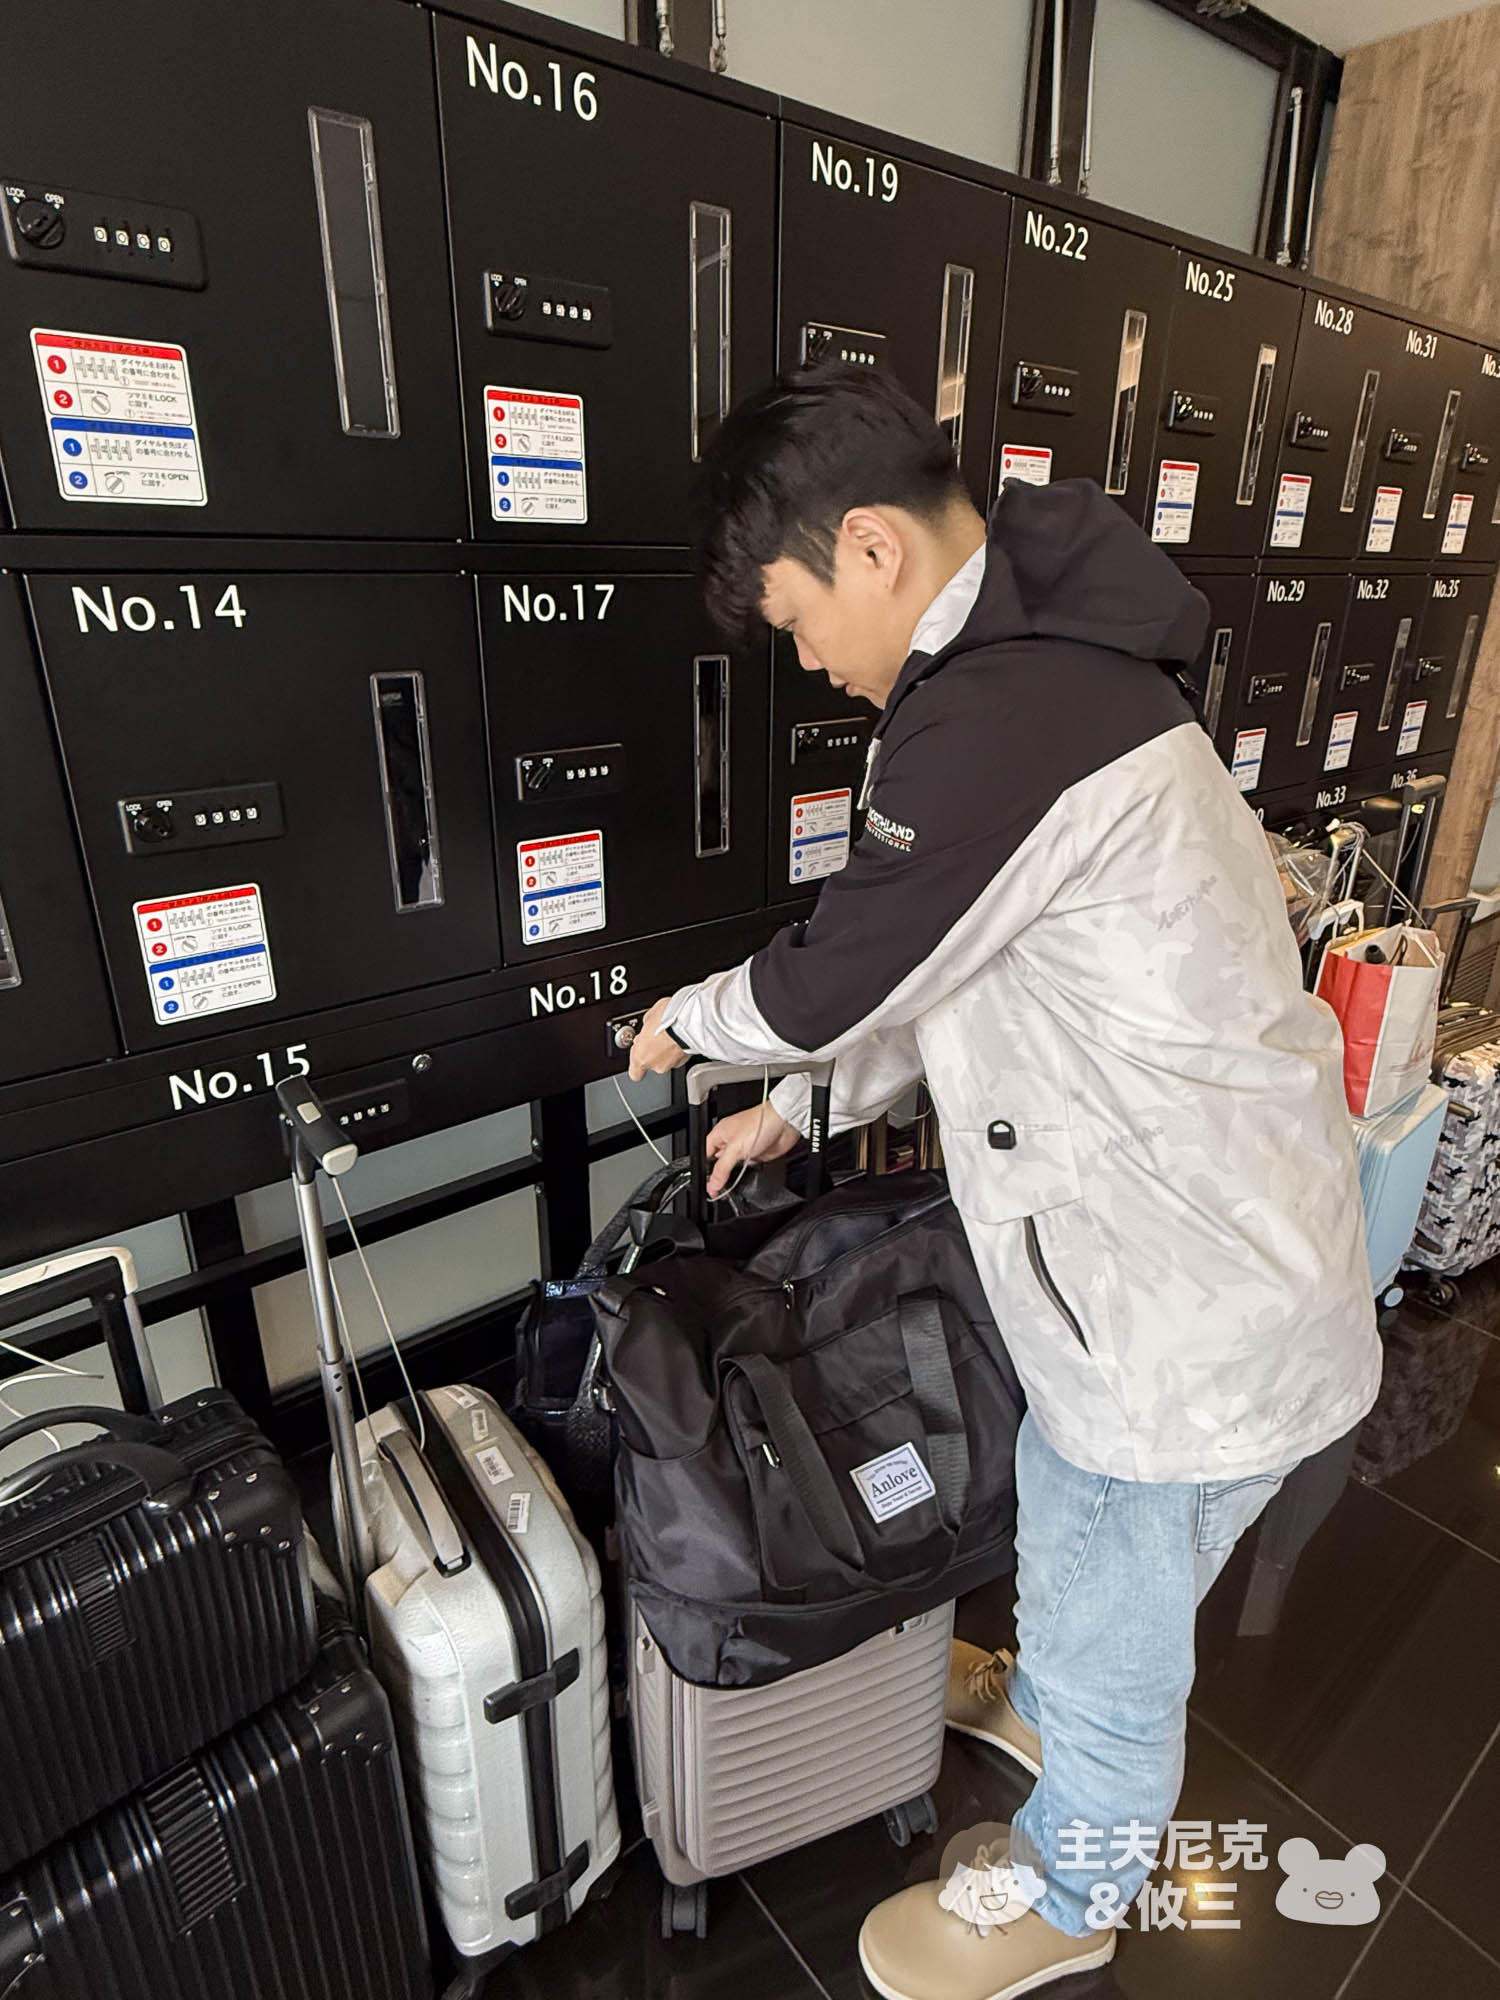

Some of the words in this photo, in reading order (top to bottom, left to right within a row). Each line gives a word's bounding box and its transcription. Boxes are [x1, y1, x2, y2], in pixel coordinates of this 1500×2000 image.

[466, 35, 597, 121] No.16
[811, 141, 898, 203] No.19
[6, 187, 25, 198] LOCK
[44, 193, 64, 204] OPEN
[1025, 210, 1090, 262] No.22
[1185, 261, 1235, 302] No.25
[1314, 299, 1354, 335] No.28
[1405, 329, 1438, 359] No.31
[503, 584, 615, 623] No.17
[1267, 580, 1305, 602] No.29
[1357, 579, 1389, 600] No.32
[1433, 580, 1460, 598] No.35
[72, 584, 246, 633] No.14
[1316, 785, 1347, 809] No.33
[530, 965, 628, 1017] No.18
[169, 1043, 310, 1110] No.15
[872, 1467, 918, 1498] Anlove
